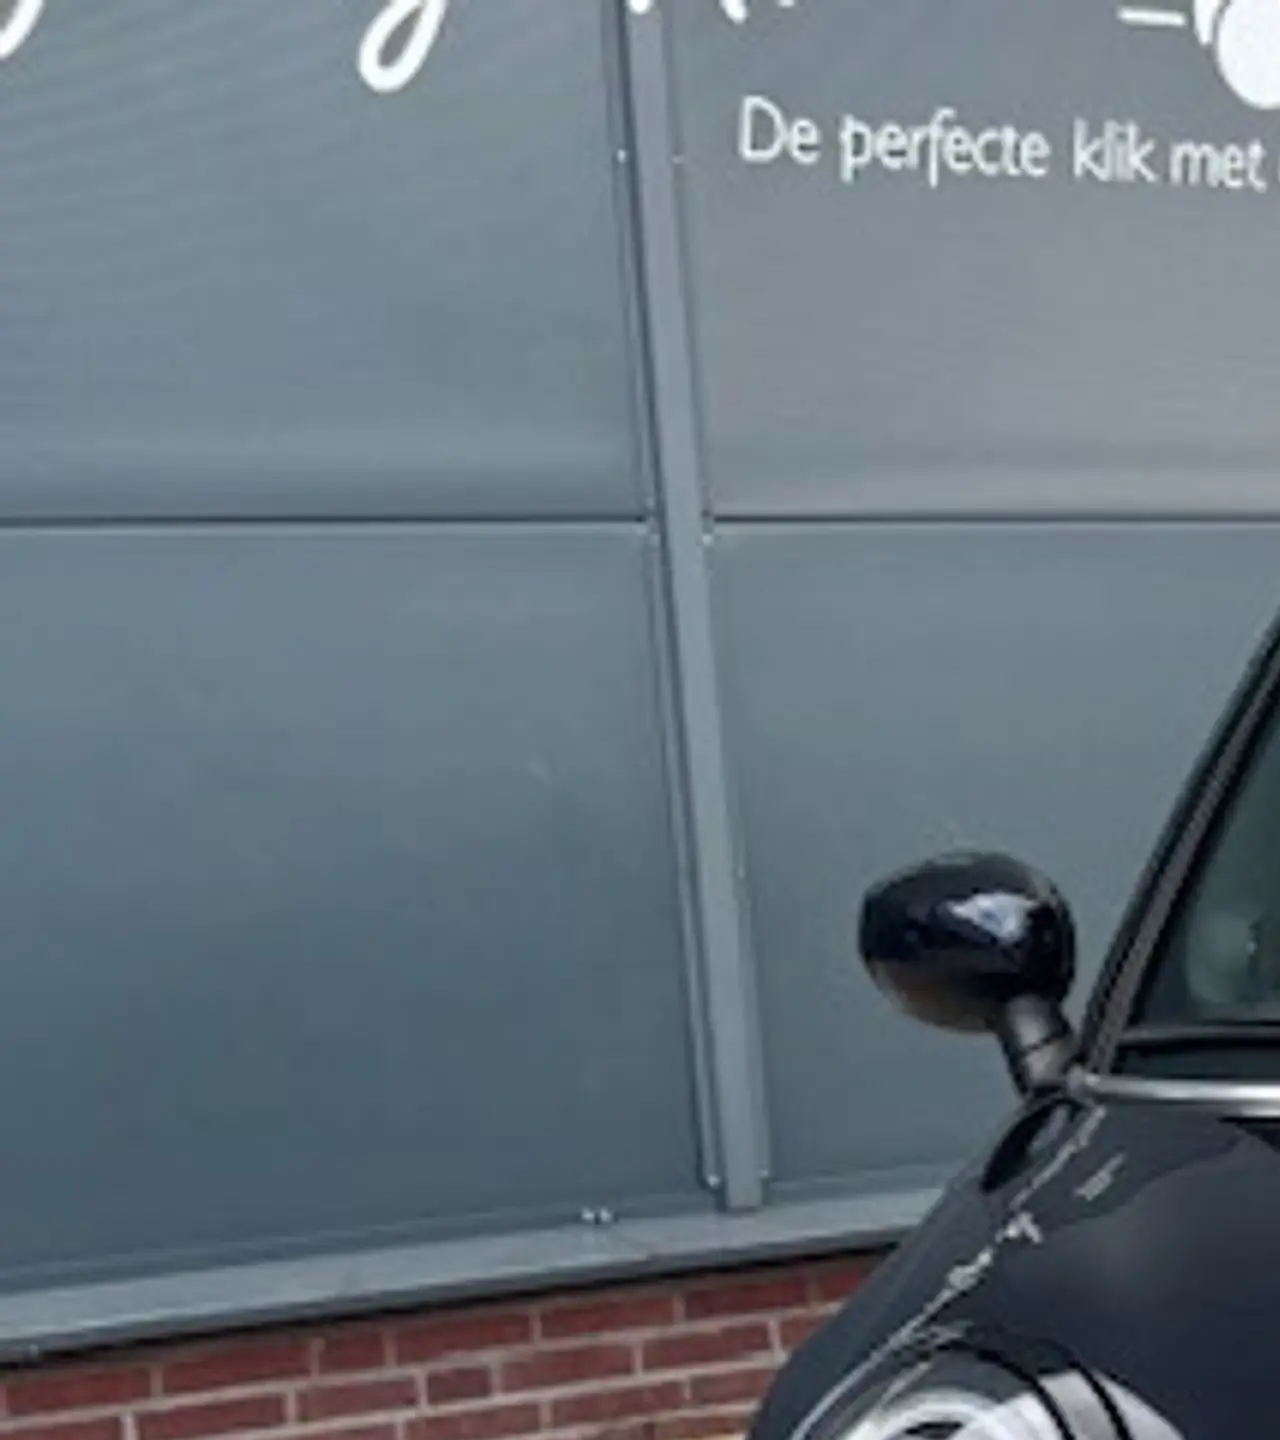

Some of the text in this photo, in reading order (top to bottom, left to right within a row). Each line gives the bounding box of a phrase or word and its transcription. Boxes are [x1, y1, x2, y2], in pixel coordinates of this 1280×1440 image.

[739, 95, 821, 164] De
[839, 108, 1051, 187] perfecte
[1073, 117, 1156, 182] klik
[1169, 138, 1267, 191] met
